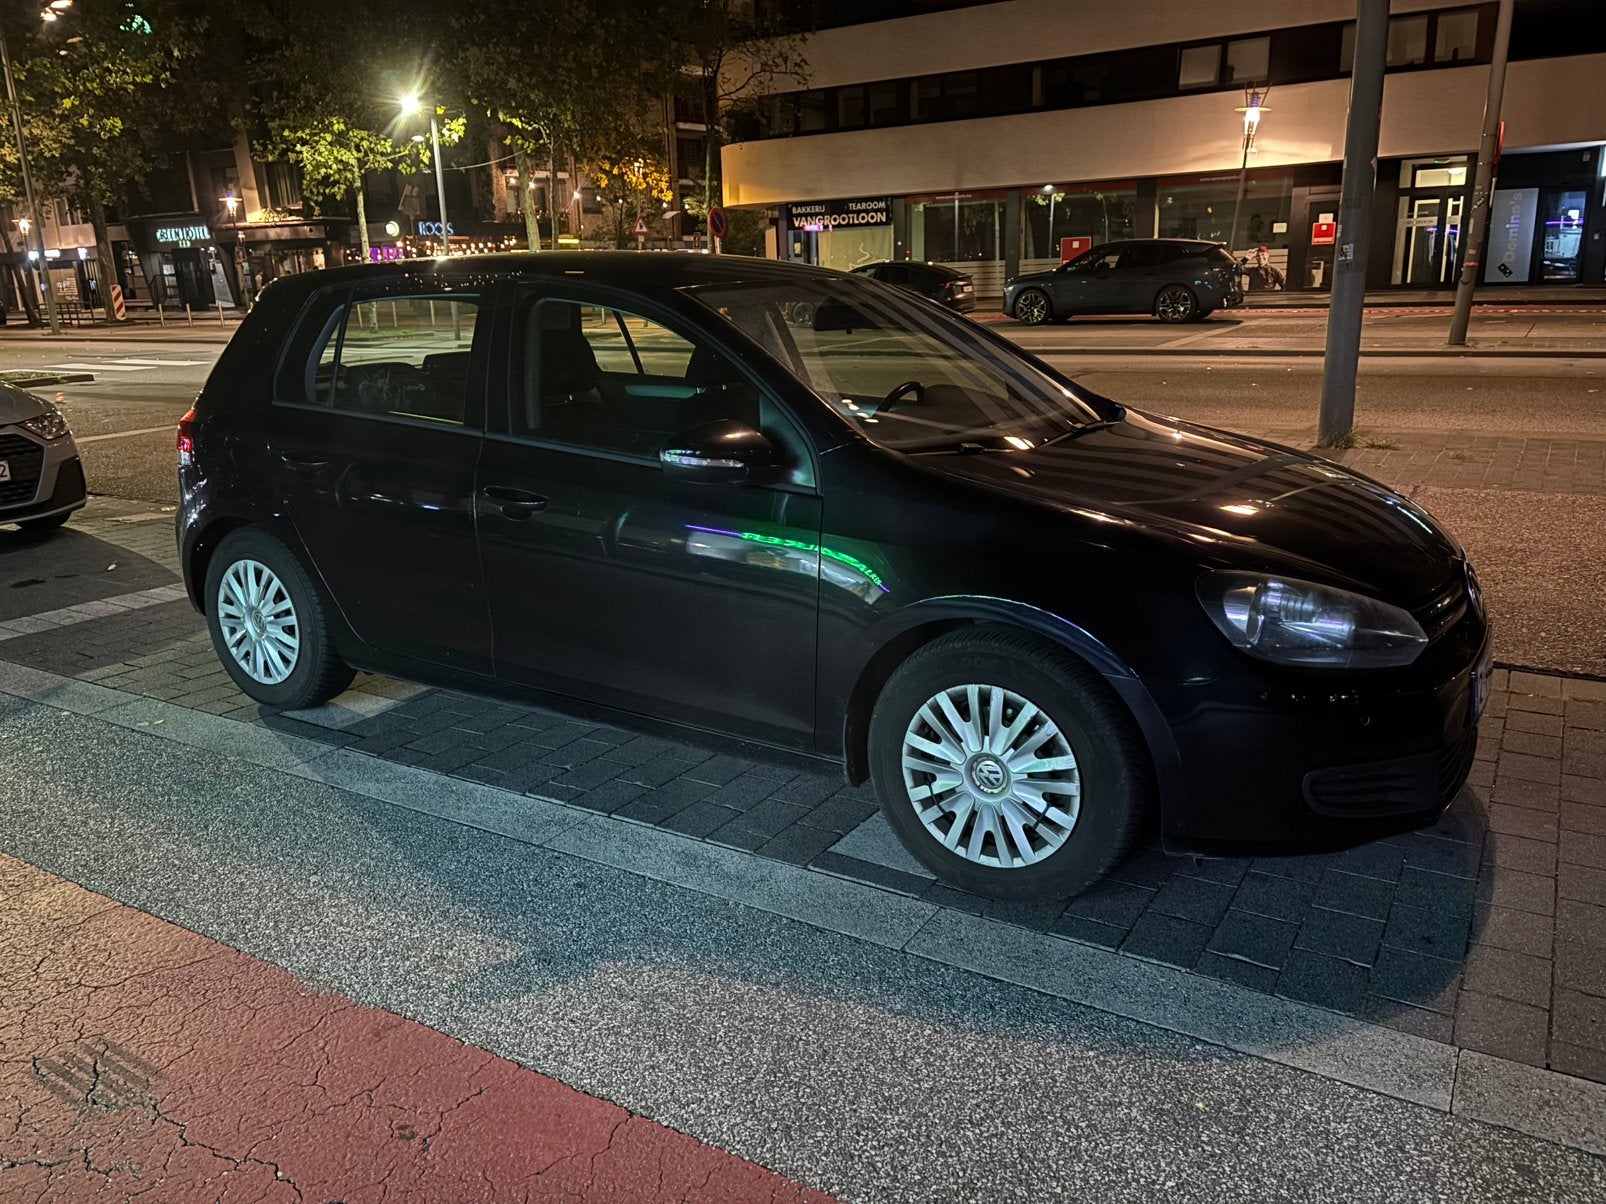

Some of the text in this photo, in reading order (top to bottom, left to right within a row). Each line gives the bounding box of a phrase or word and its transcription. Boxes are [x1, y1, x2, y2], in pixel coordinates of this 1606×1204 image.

[792, 201, 886, 214] BAKKERIJ TEAROOM
[793, 211, 887, 228] VANGROOTLOON
[1503, 192, 1522, 263] Domino's
